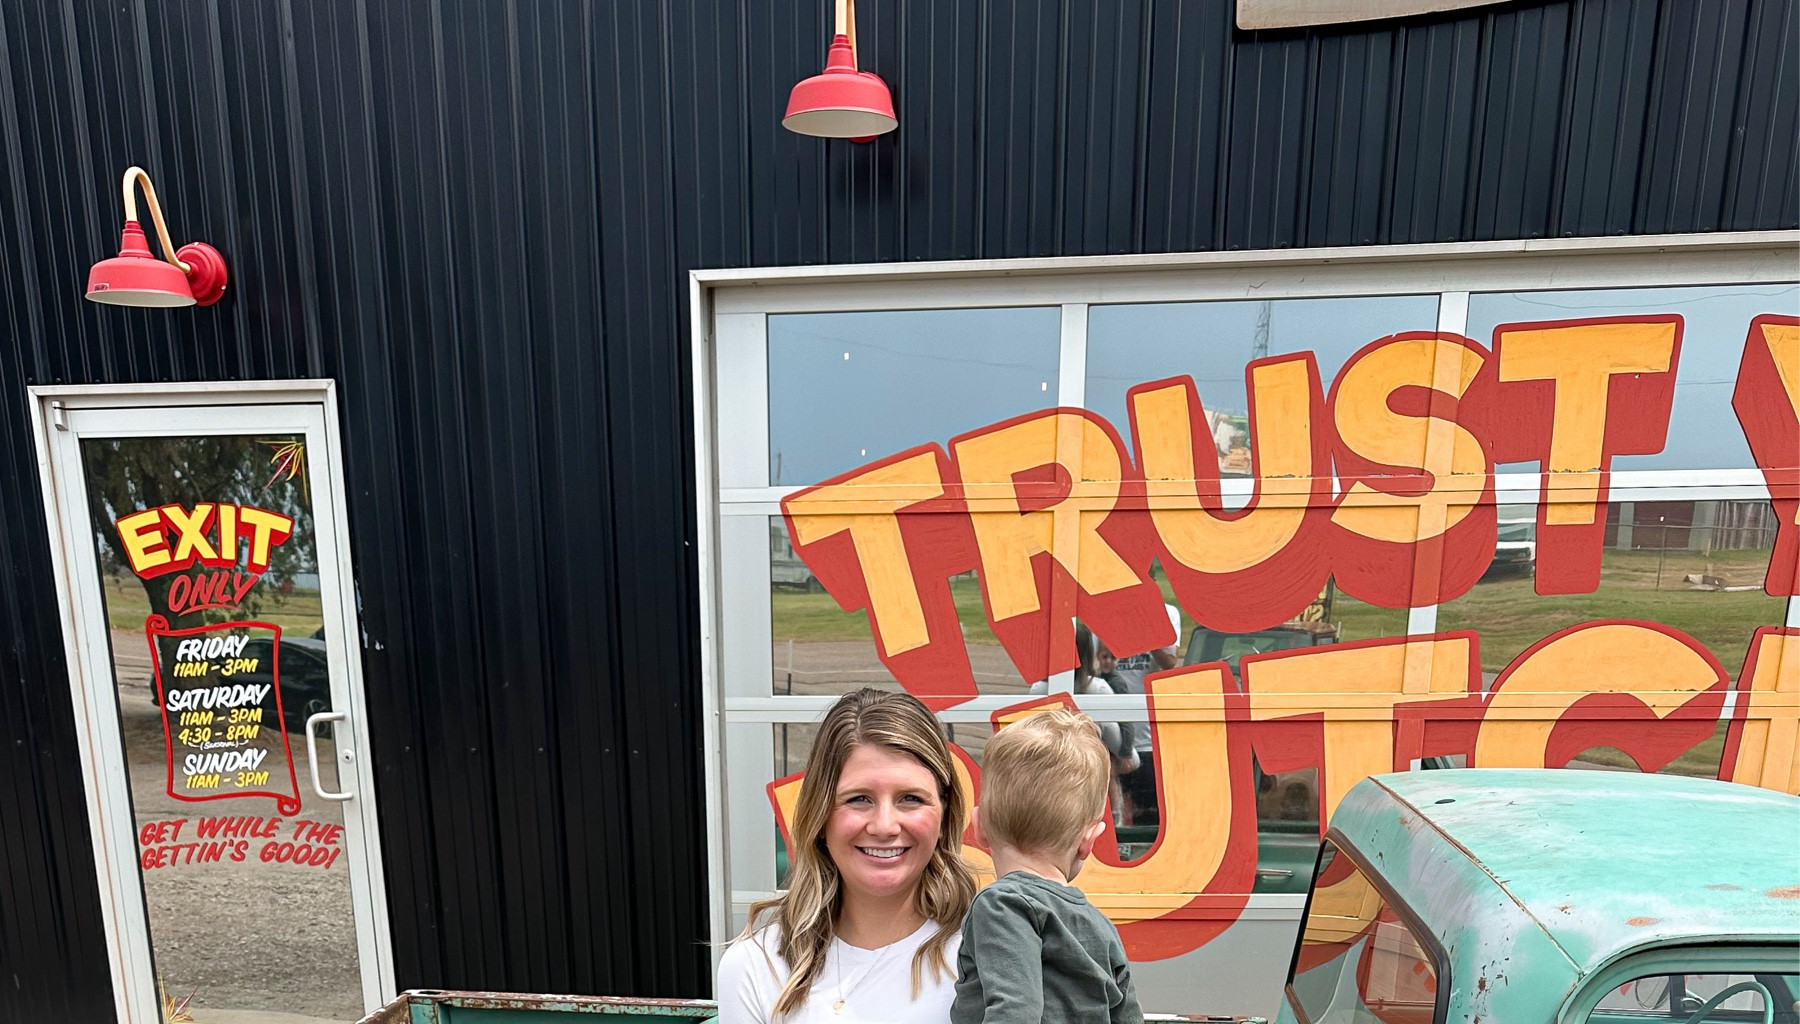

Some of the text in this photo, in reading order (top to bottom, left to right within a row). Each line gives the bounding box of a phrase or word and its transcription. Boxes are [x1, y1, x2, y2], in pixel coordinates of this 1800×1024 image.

[780, 312, 1685, 714] TRUST
[115, 502, 295, 580] EXIT
[168, 571, 259, 613] ONLY
[176, 635, 250, 662] FRIDAY
[173, 661, 209, 678] 11AM
[221, 658, 259, 676] 3PM
[166, 683, 272, 712] SATURDAY
[180, 711, 214, 726] 11AM
[228, 707, 263, 723] 3PM
[178, 727, 212, 746] 4:30
[226, 724, 260, 741] 8PM
[183, 747, 268, 776] SUNDAY
[186, 773, 220, 789] 11AM
[235, 771, 270, 788] 3PM
[140, 816, 344, 846] GET WHILE THE
[141, 839, 341, 870] GETTIN'S GOOD!
